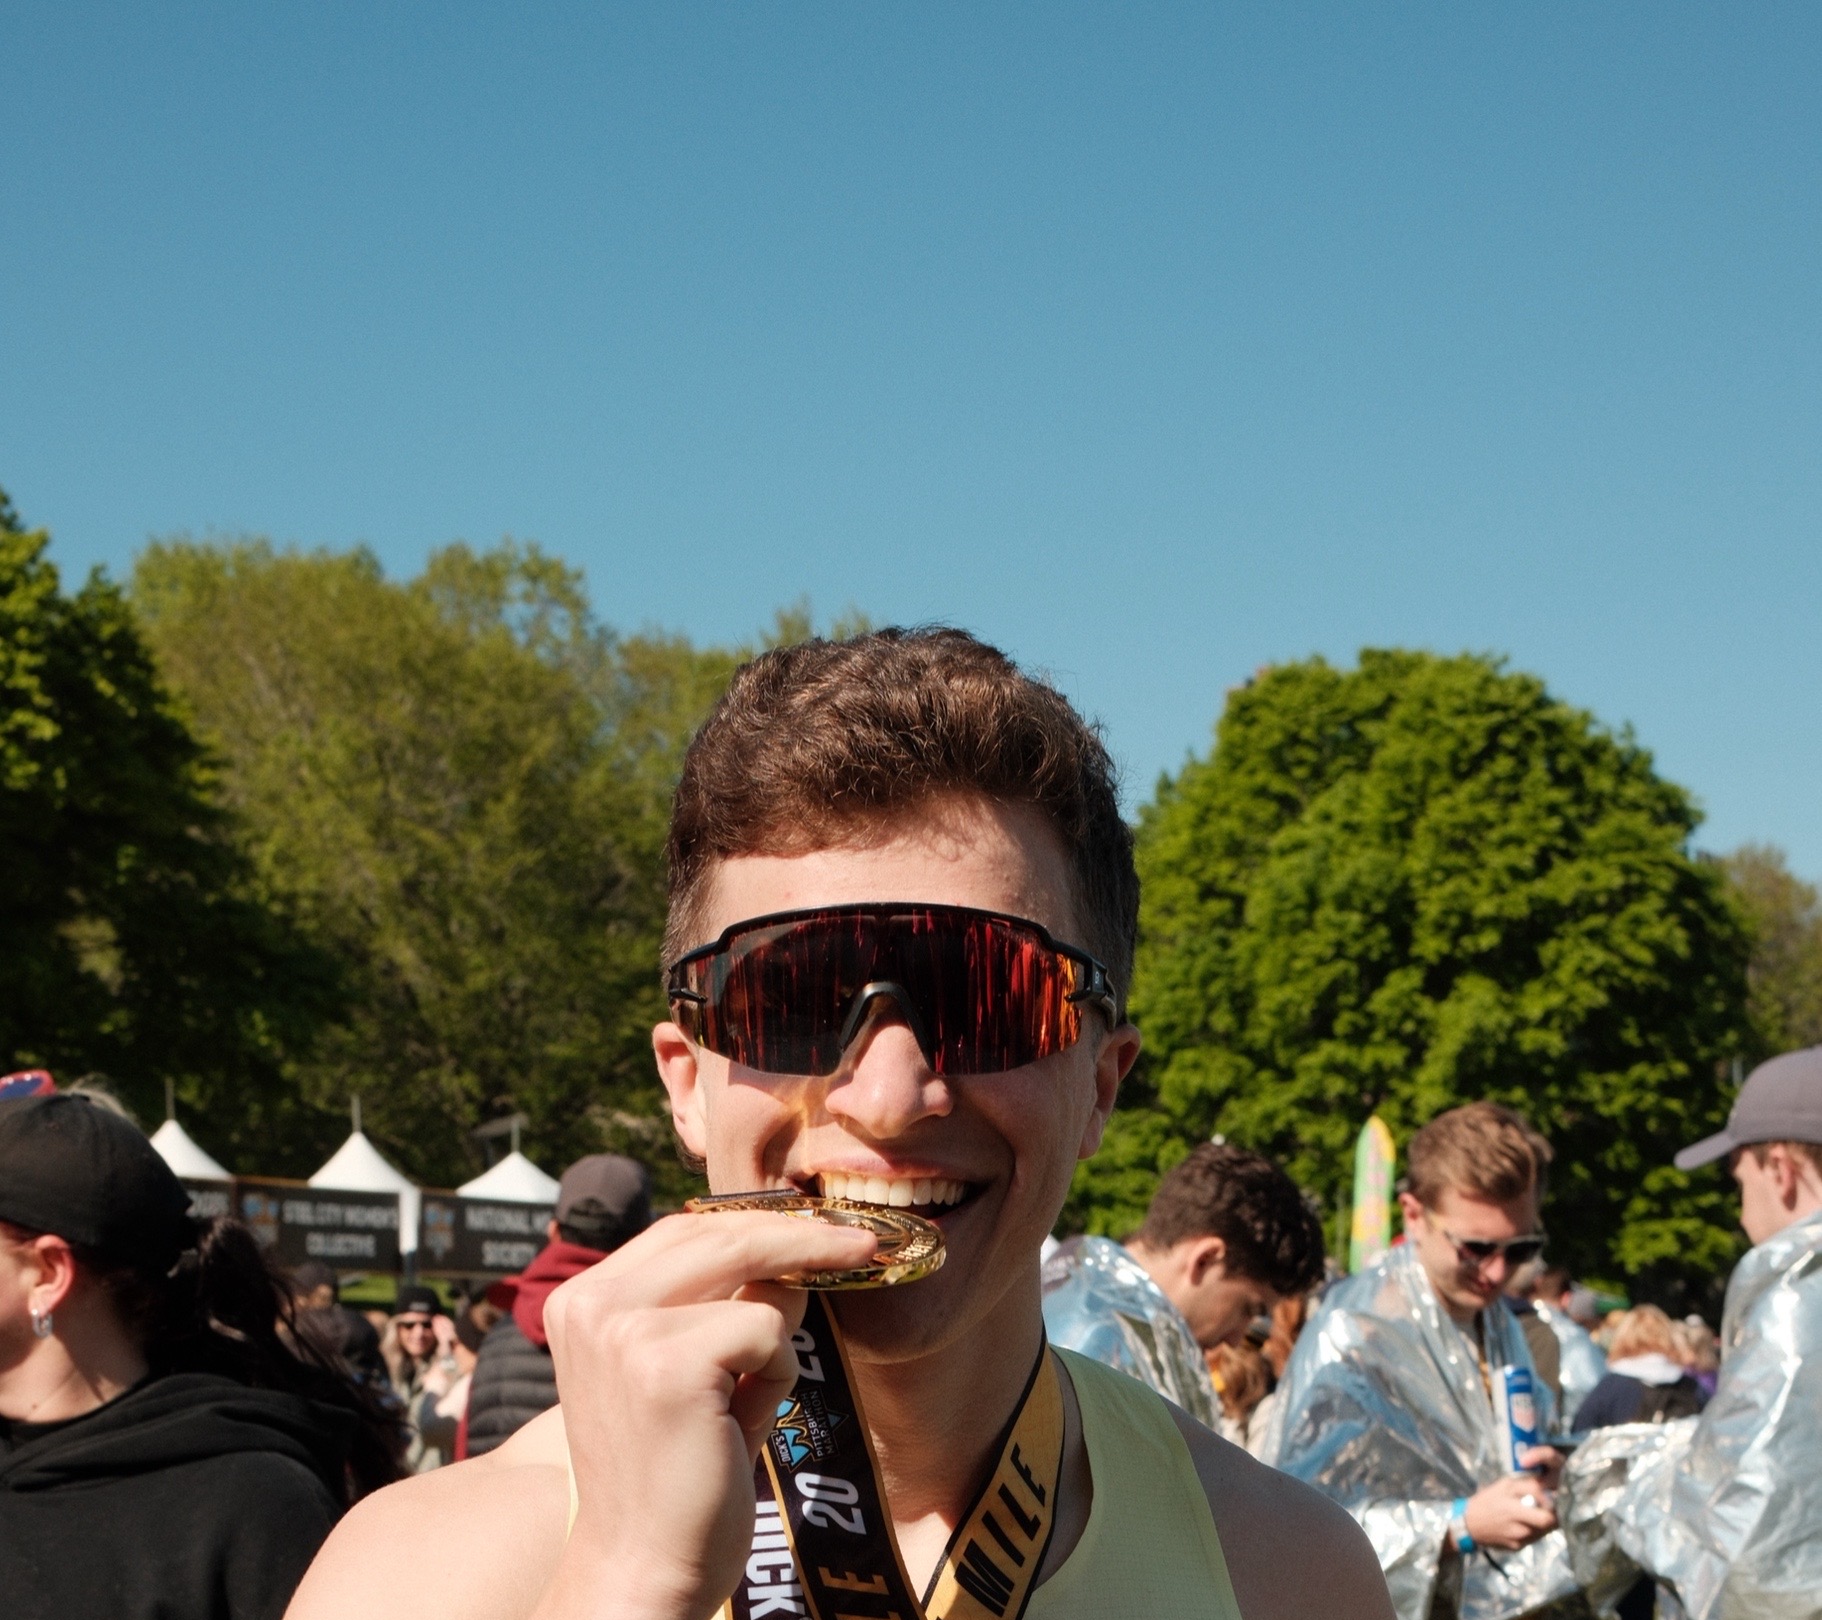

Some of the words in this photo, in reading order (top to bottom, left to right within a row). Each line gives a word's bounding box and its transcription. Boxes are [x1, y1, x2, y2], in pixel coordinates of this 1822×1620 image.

[775, 1434, 792, 1463] DICK'S
[801, 1392, 824, 1457] PITTSBURGH
[810, 1390, 835, 1455] MARATHON
[794, 1472, 867, 1535] 20
[954, 1442, 1046, 1618] MILE
